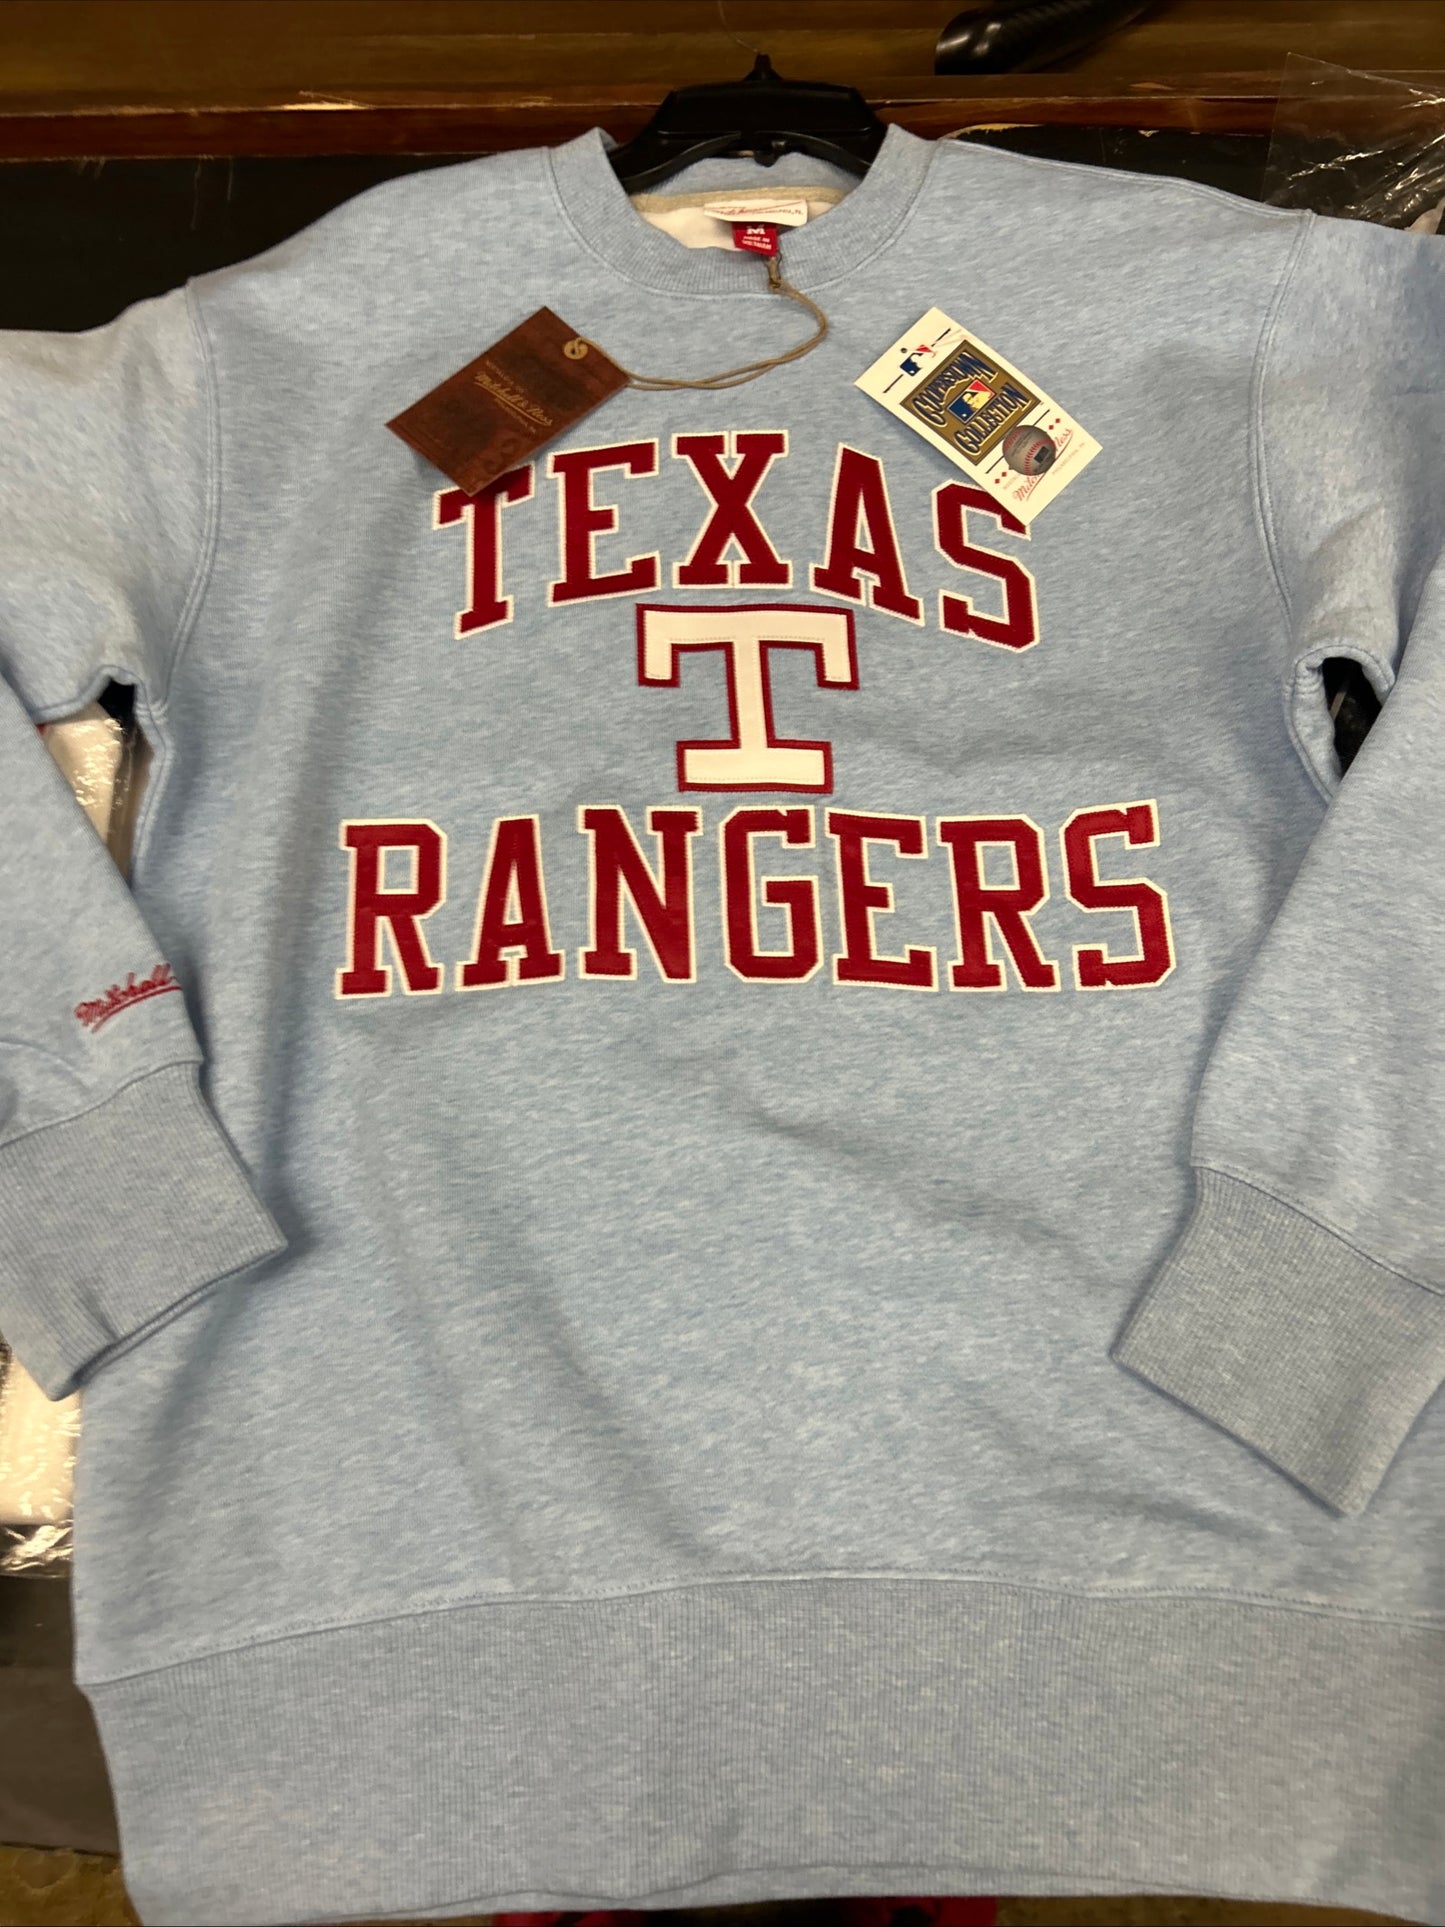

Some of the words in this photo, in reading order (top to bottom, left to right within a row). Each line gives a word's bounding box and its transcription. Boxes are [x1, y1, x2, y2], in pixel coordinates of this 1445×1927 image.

[746, 224, 767, 236] M
[911, 350, 999, 428] COOPERSTOWN
[953, 382, 1032, 456] COLLECTION
[432, 429, 1041, 653] TEXAS
[636, 603, 860, 794] T
[334, 799, 1178, 1000] RANGERS
